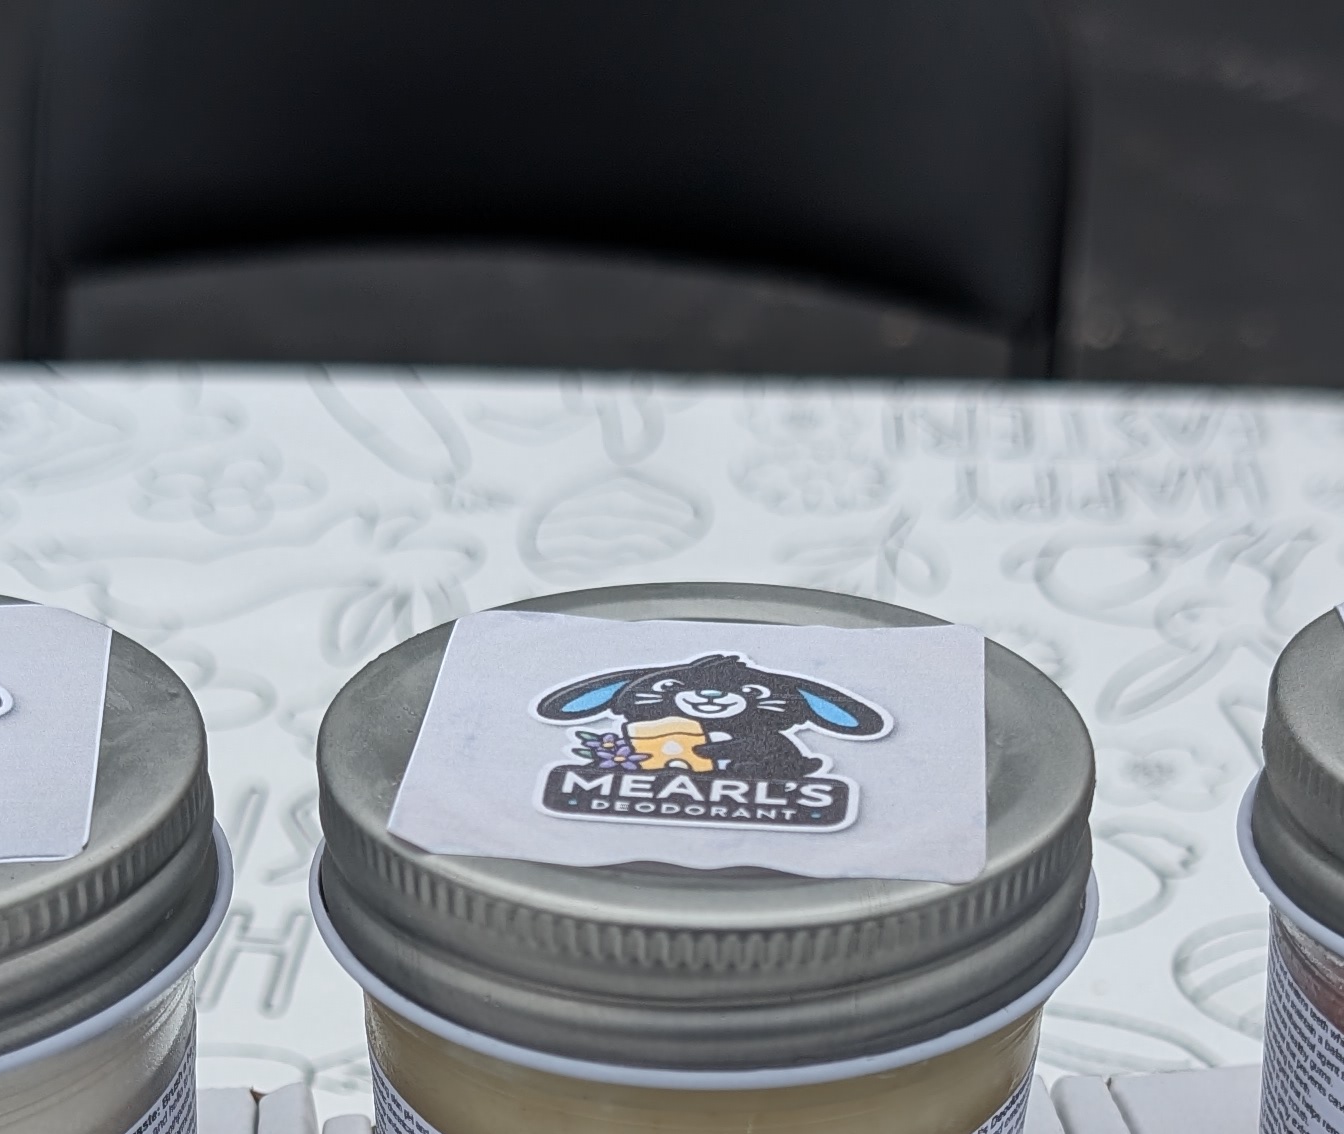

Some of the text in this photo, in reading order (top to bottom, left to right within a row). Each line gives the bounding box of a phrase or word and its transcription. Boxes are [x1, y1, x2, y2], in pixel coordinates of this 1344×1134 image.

[941, 461, 1270, 525] HAPPY
[561, 771, 834, 808] MEARL'S
[590, 799, 798, 821] DEODORANT
